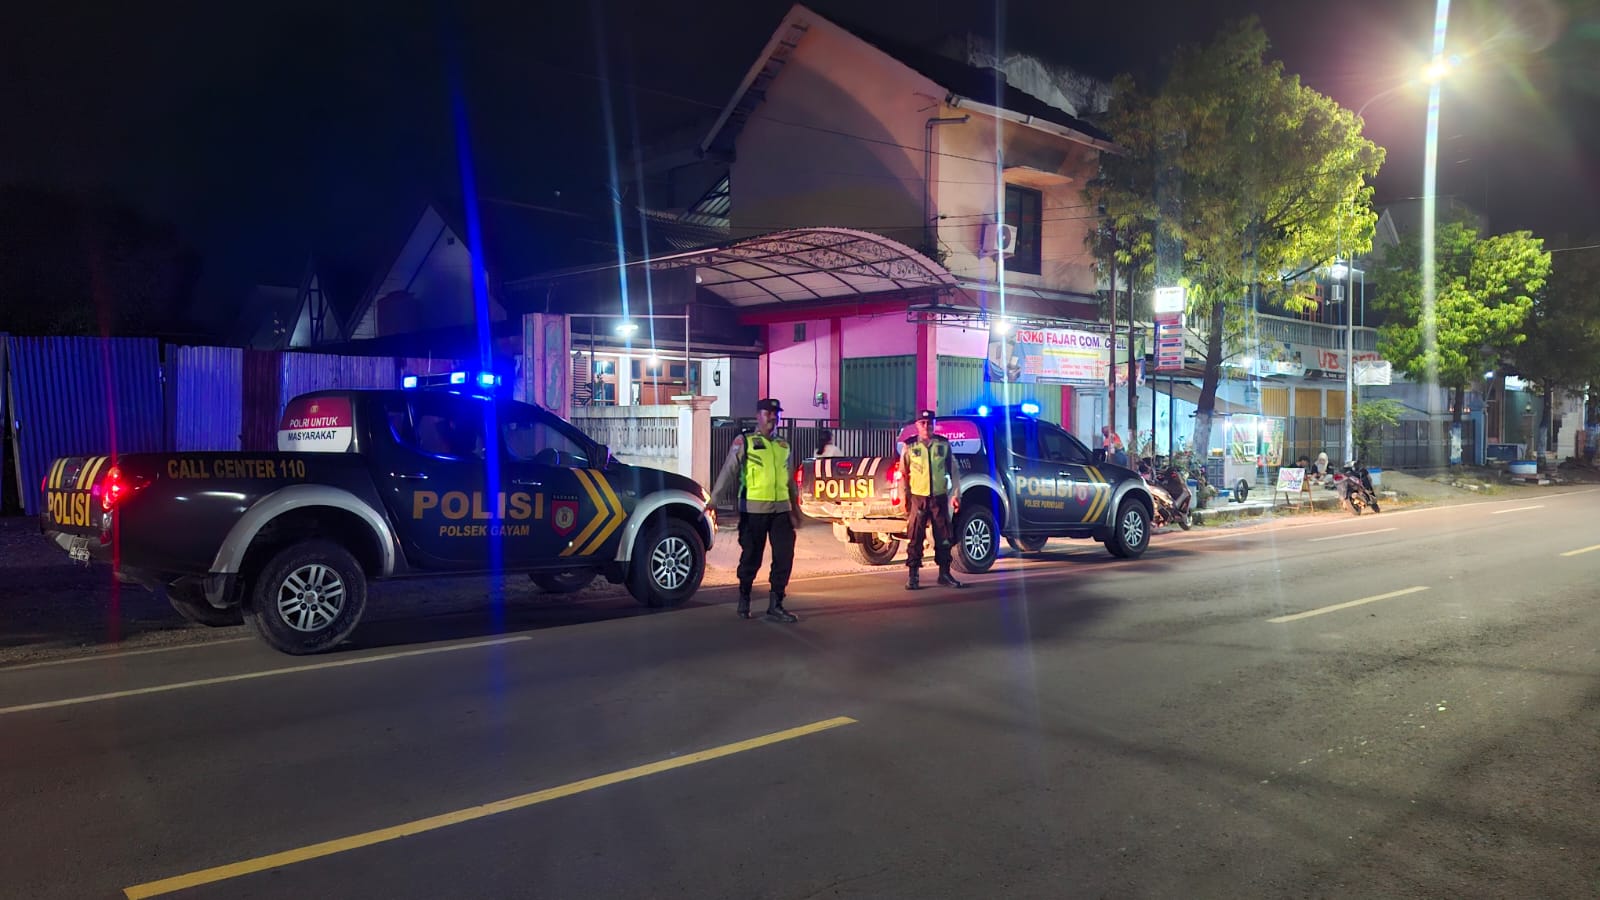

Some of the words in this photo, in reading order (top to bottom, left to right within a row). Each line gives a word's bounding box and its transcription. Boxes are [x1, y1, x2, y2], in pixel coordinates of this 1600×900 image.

[1017, 330, 1044, 344] TOKO
[1046, 332, 1077, 346] FAJAR
[1104, 337, 1127, 350] CLL
[289, 418, 309, 429] POLRI
[310, 416, 338, 427] UNTUK
[288, 430, 337, 441] MASYARAKAT
[167, 459, 210, 479] CALL
[213, 459, 277, 479] CENTER
[279, 459, 306, 479] 110
[814, 478, 875, 499] POLISI
[1016, 475, 1073, 498] POLISI
[47, 491, 92, 527] POLISI
[413, 490, 544, 520] POLISI
[439, 525, 488, 537] POLSEK
[490, 525, 530, 537] GAYAM
